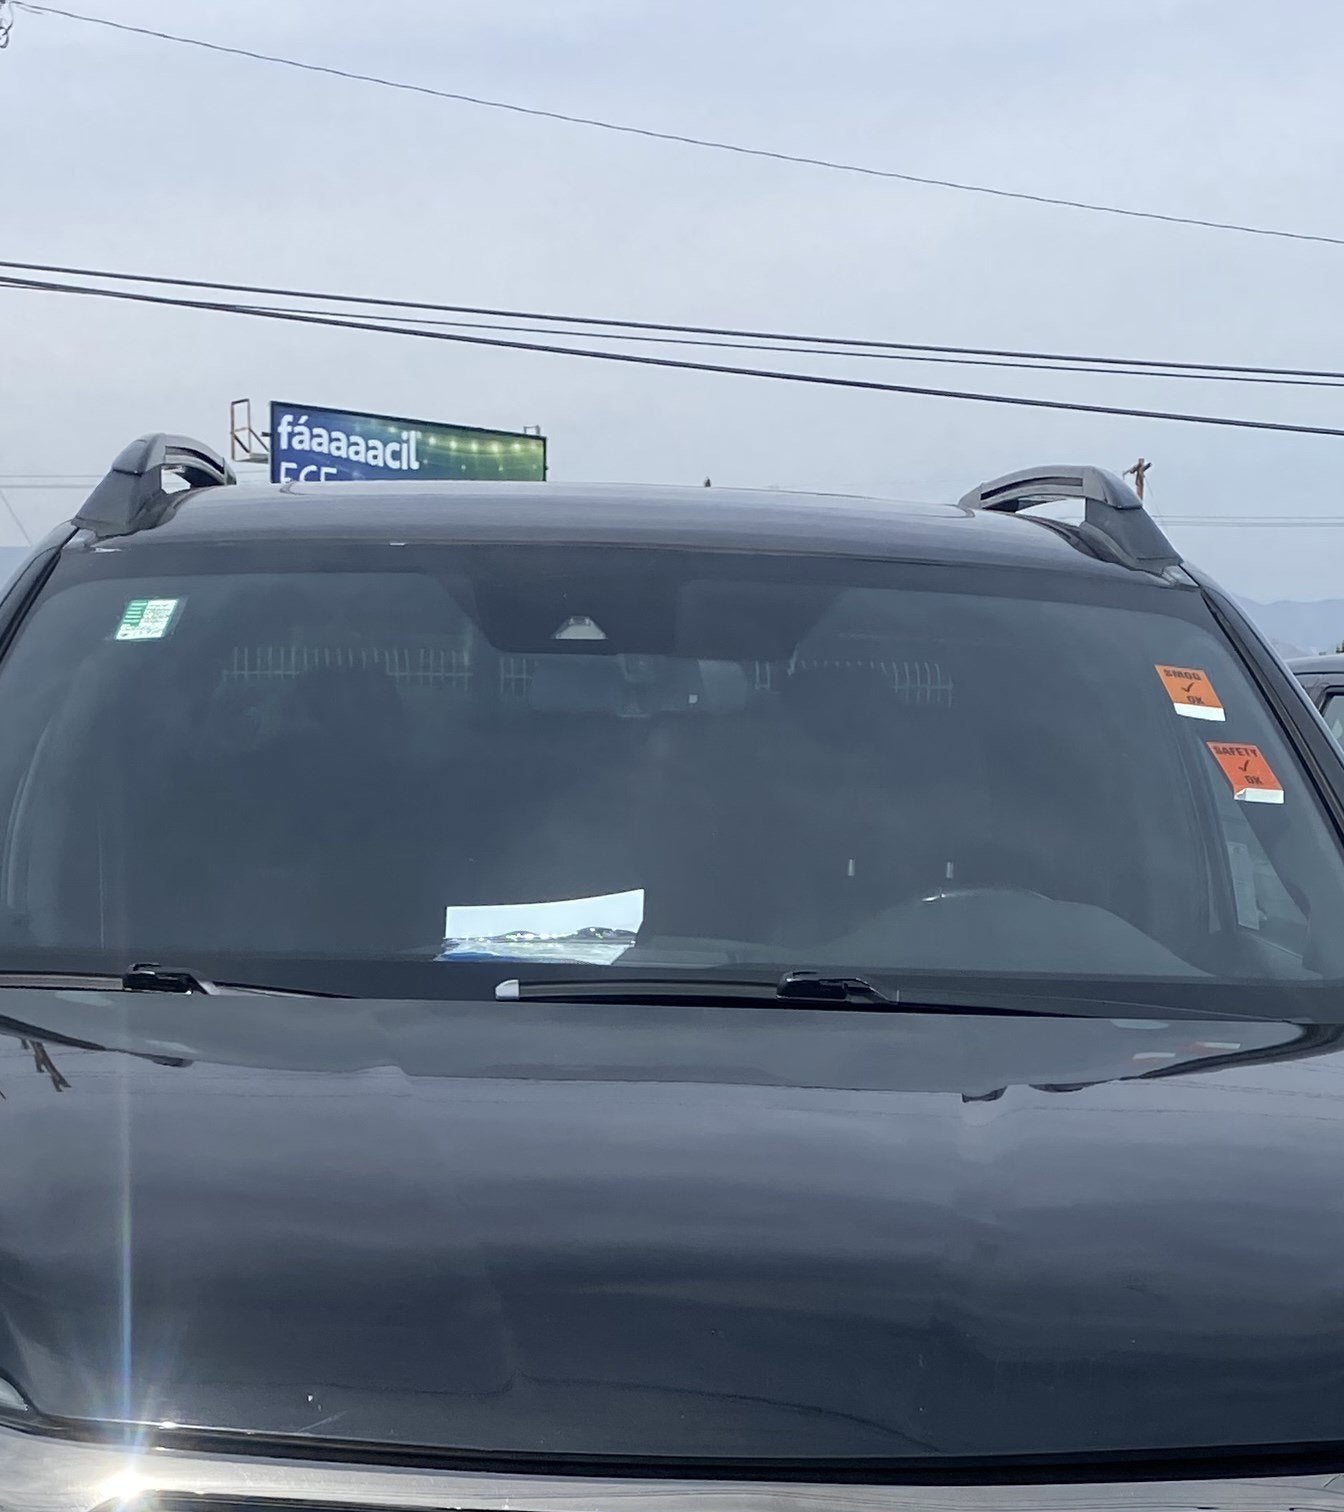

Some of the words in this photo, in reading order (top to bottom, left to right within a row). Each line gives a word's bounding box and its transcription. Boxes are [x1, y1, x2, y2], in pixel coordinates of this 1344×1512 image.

[277, 414, 421, 471] fáaaaacil
[1163, 669, 1202, 681] SMOG
[1212, 746, 1261, 758] SAFETY
